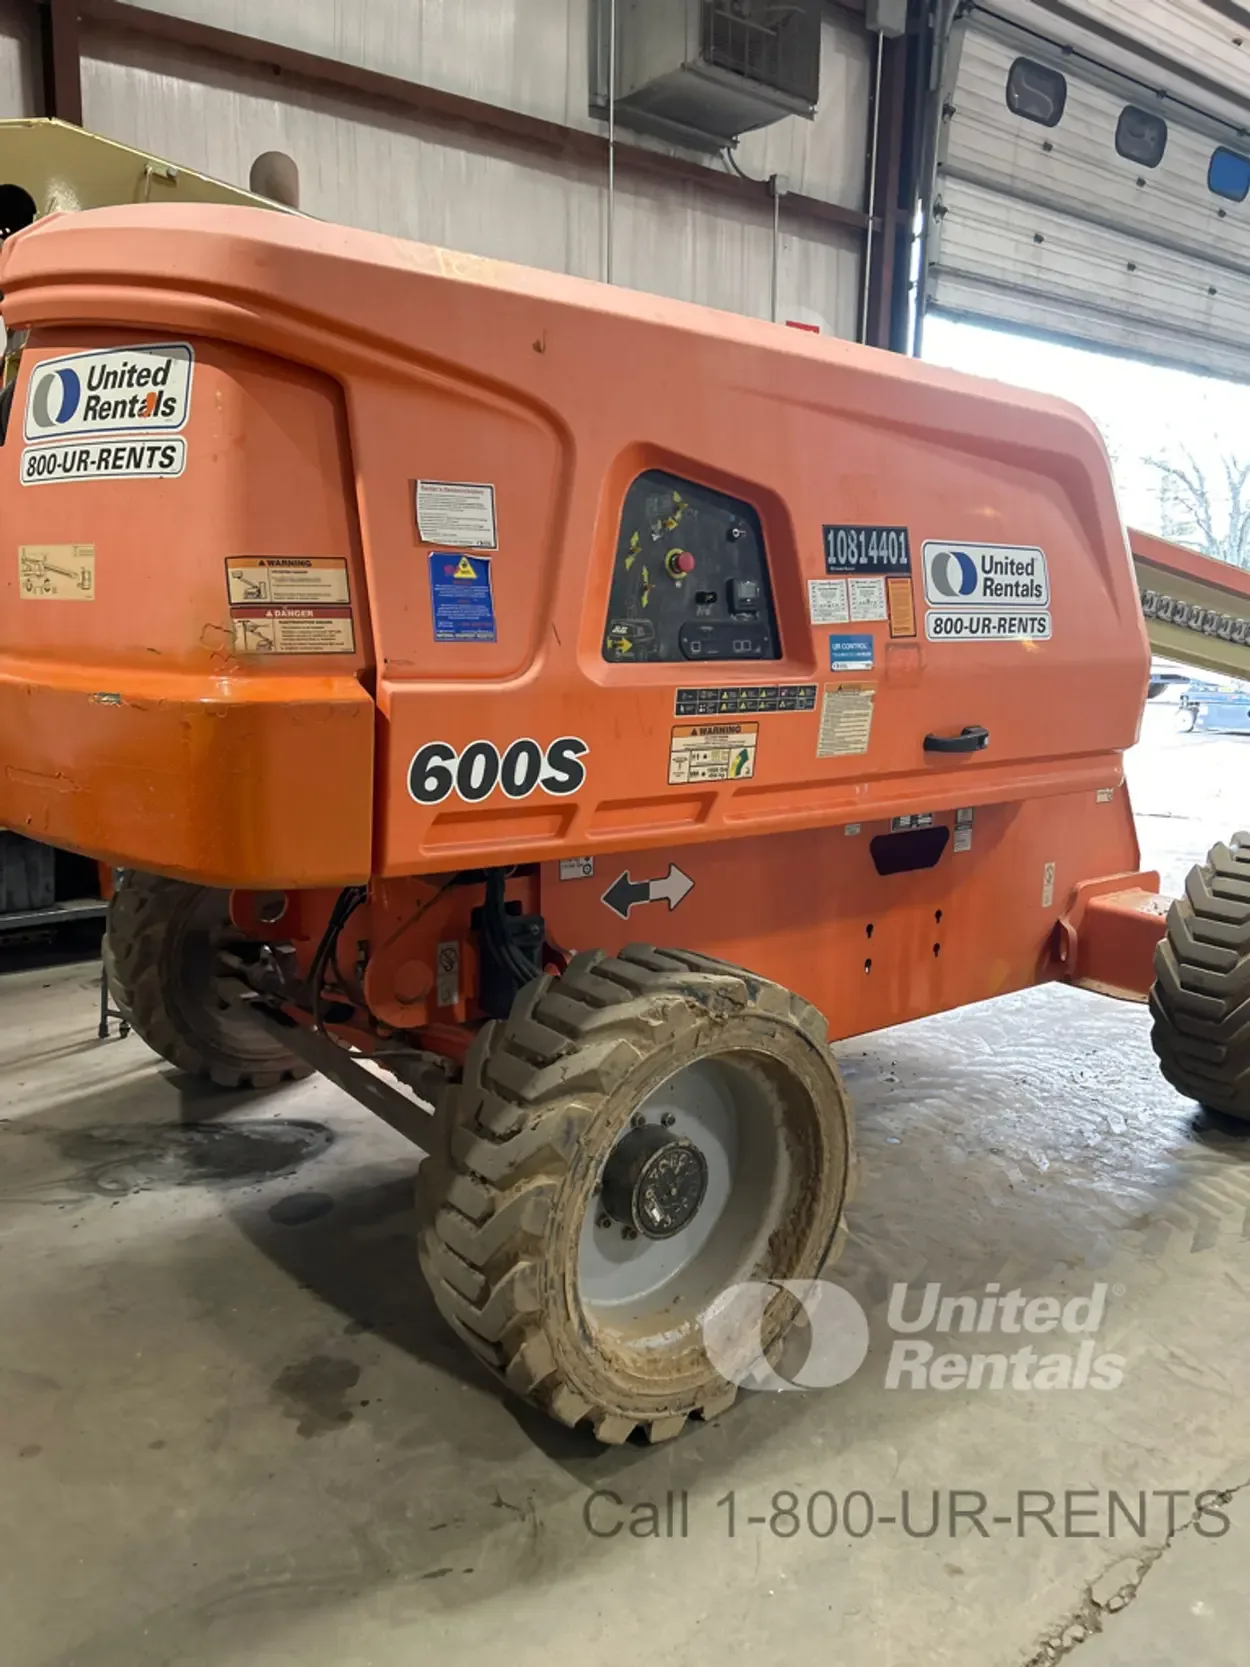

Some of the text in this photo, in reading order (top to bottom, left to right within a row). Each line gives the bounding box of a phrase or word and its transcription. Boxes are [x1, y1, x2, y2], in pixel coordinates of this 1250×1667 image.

[87, 359, 172, 391] United
[26, 445, 176, 477] 800-UR-RENTS
[828, 529, 908, 564] 10814401
[268, 560, 312, 568] WARNING
[981, 555, 1035, 576] United
[983, 577, 1043, 598] Rentals
[933, 617, 1047, 634] 800-UR-RENTS
[699, 726, 742, 736] WARNING
[406, 736, 590, 804] 600S
